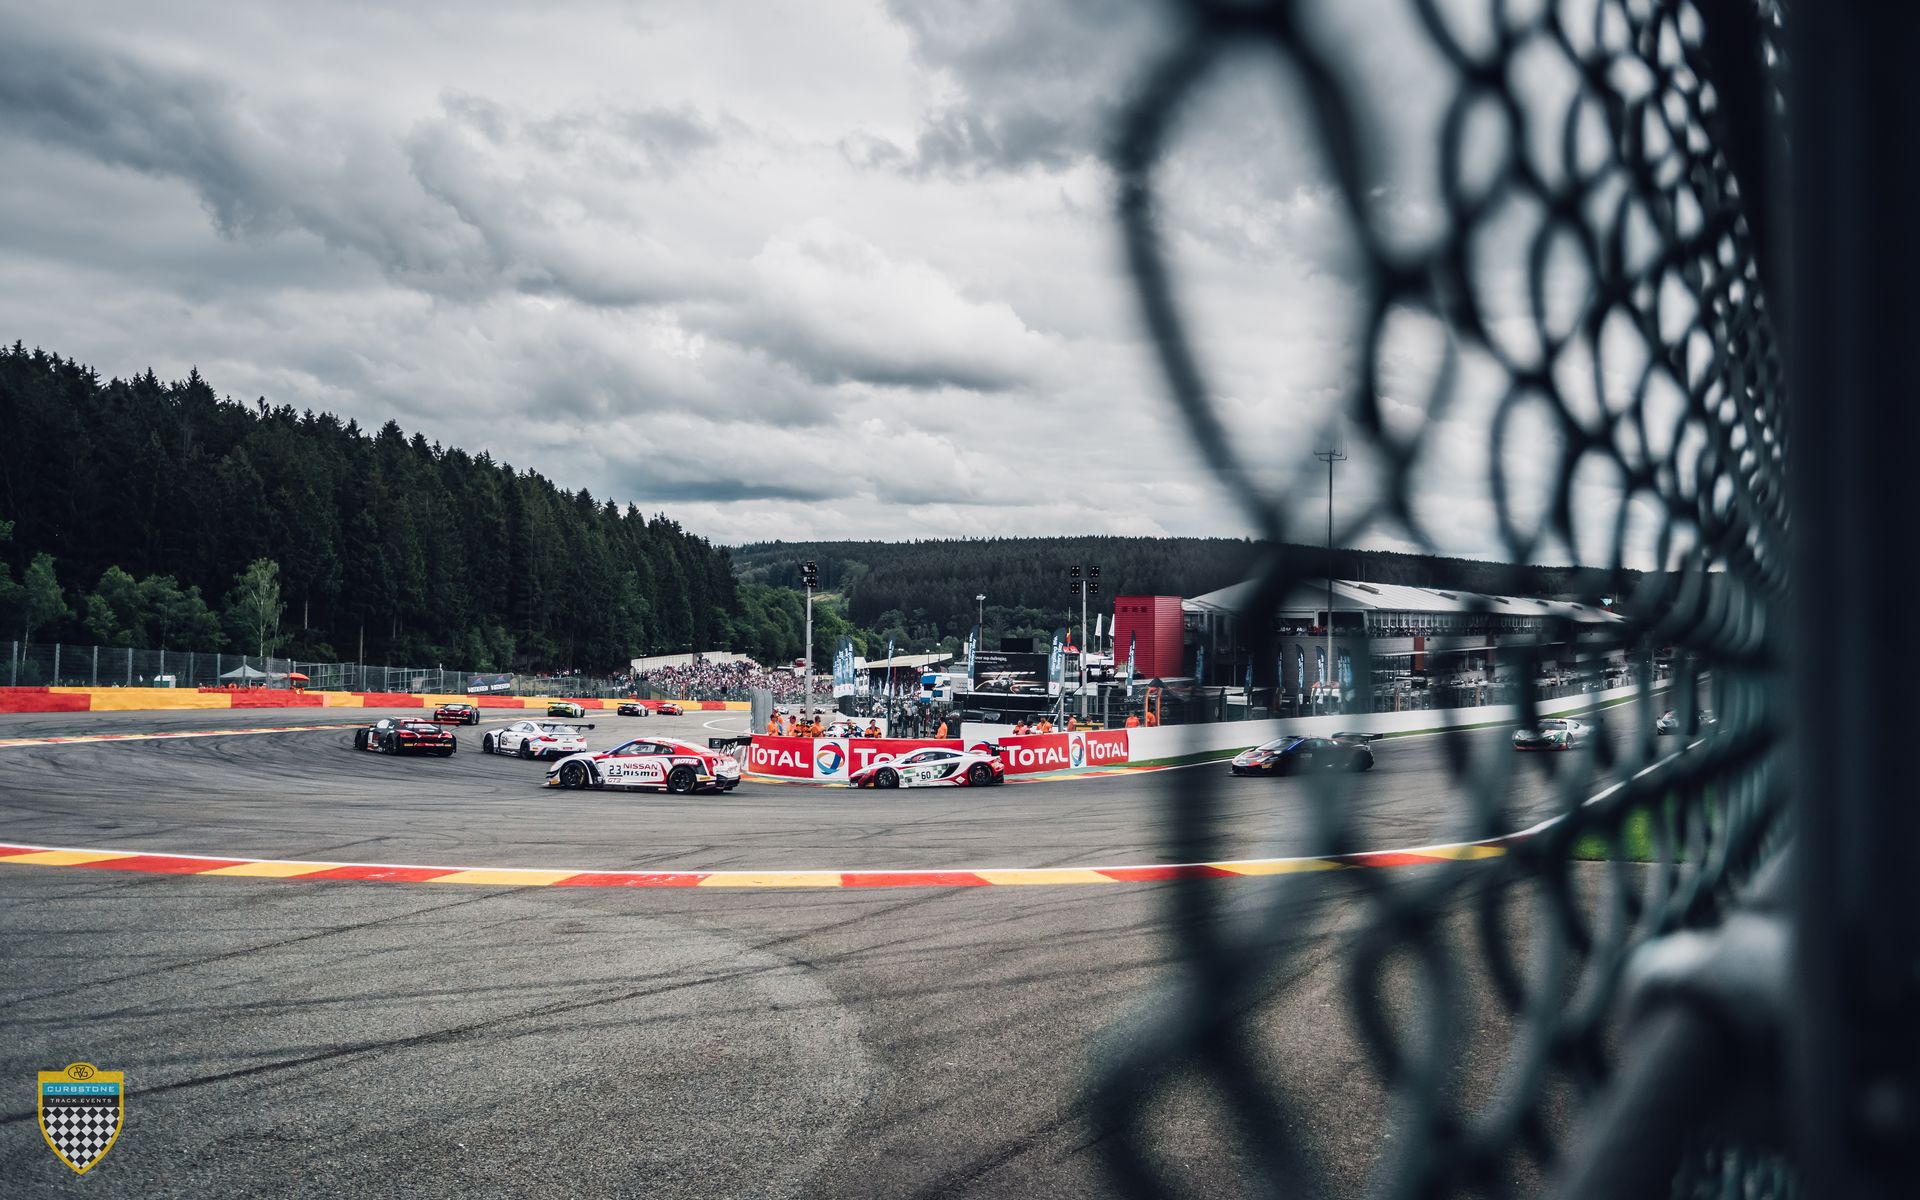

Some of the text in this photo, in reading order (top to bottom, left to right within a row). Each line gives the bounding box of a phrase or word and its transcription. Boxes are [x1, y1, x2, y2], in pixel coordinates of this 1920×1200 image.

[750, 743, 809, 768] TOTAL
[1007, 745, 1068, 766] TOTAL
[1088, 740, 1127, 759] TOTAL
[609, 765, 621, 775] 23
[921, 771, 931, 779] 60
